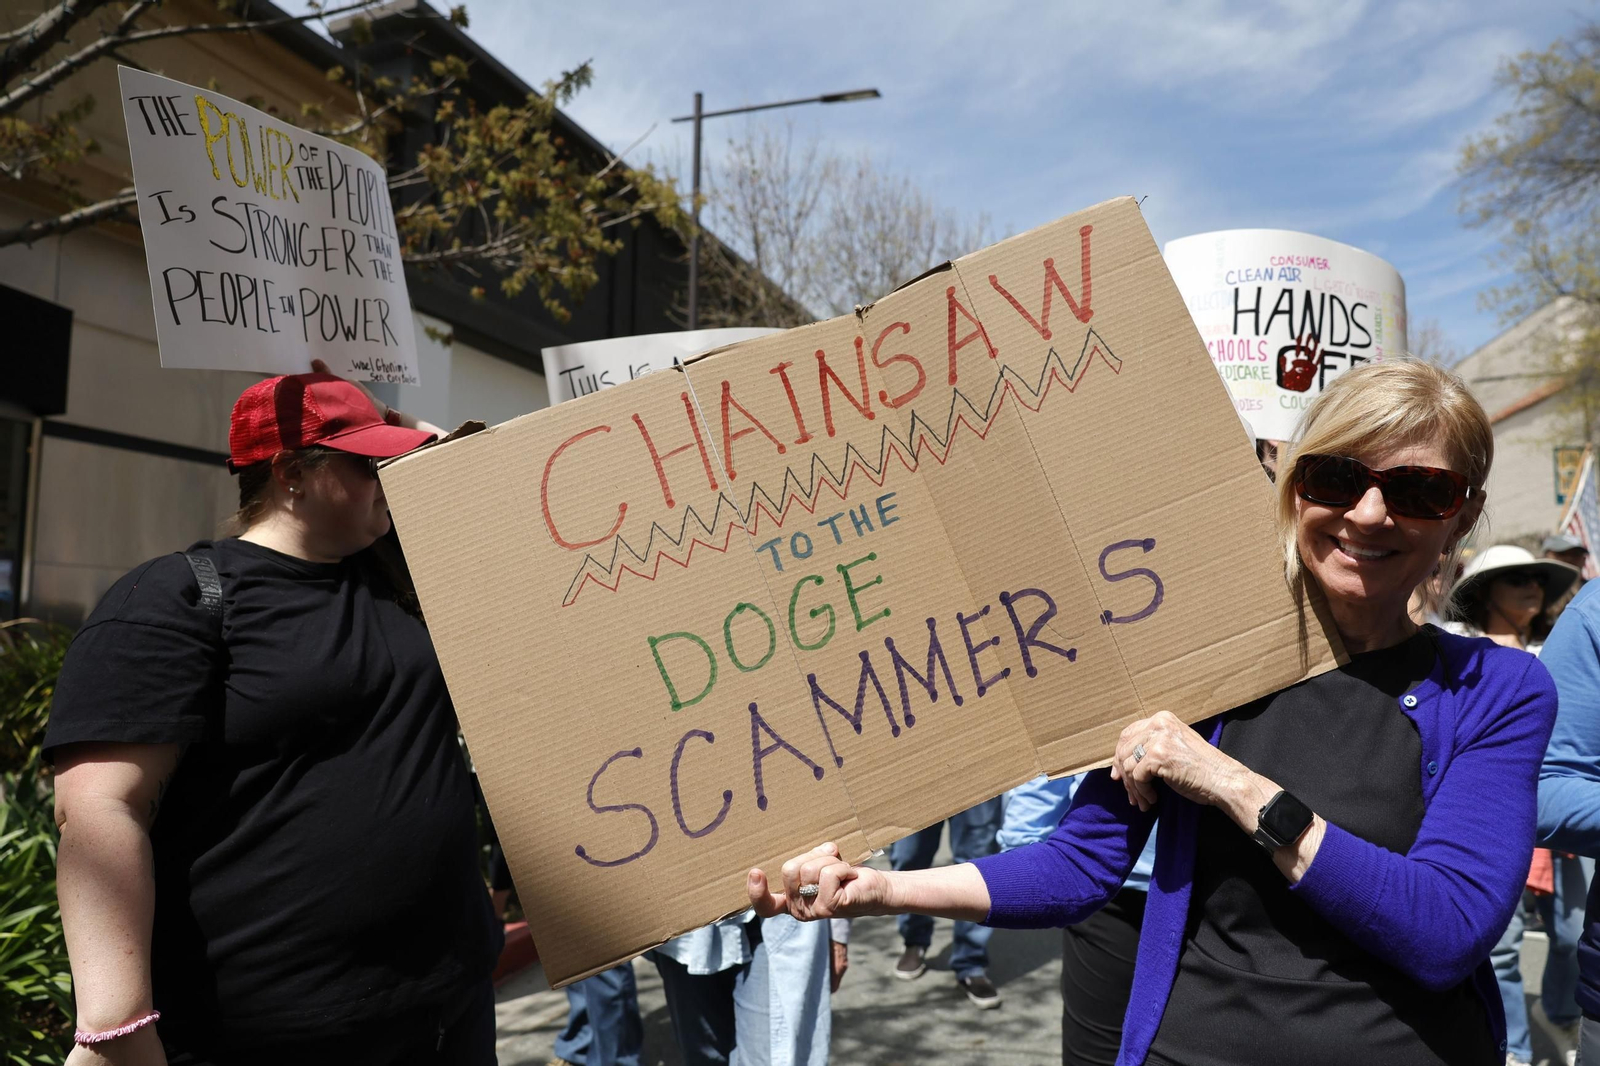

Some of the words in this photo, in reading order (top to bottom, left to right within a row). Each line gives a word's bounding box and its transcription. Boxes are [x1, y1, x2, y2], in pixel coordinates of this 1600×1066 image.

[129, 95, 197, 137] THE
[195, 94, 299, 203] POWER
[299, 143, 318, 161] OF
[294, 165, 328, 191] THE
[327, 150, 395, 239] PEOPLE
[209, 195, 363, 278] STRONGER
[362, 234, 393, 260] THAN
[368, 259, 395, 284] THE
[1225, 267, 1274, 286] CLEAN
[1278, 266, 1302, 283] AIR
[1270, 255, 1331, 270] CONSUMER
[162, 267, 281, 333] PEOPLE
[299, 288, 398, 346] POWER
[1233, 286, 1372, 349] HANDS
[1207, 338, 1268, 362] CHOOLS
[541, 224, 1093, 551] CHAINSAW
[1219, 364, 1272, 382] EDICARE
[757, 531, 813, 572] TO
[818, 491, 900, 545] THE
[647, 552, 892, 711] DOGE
